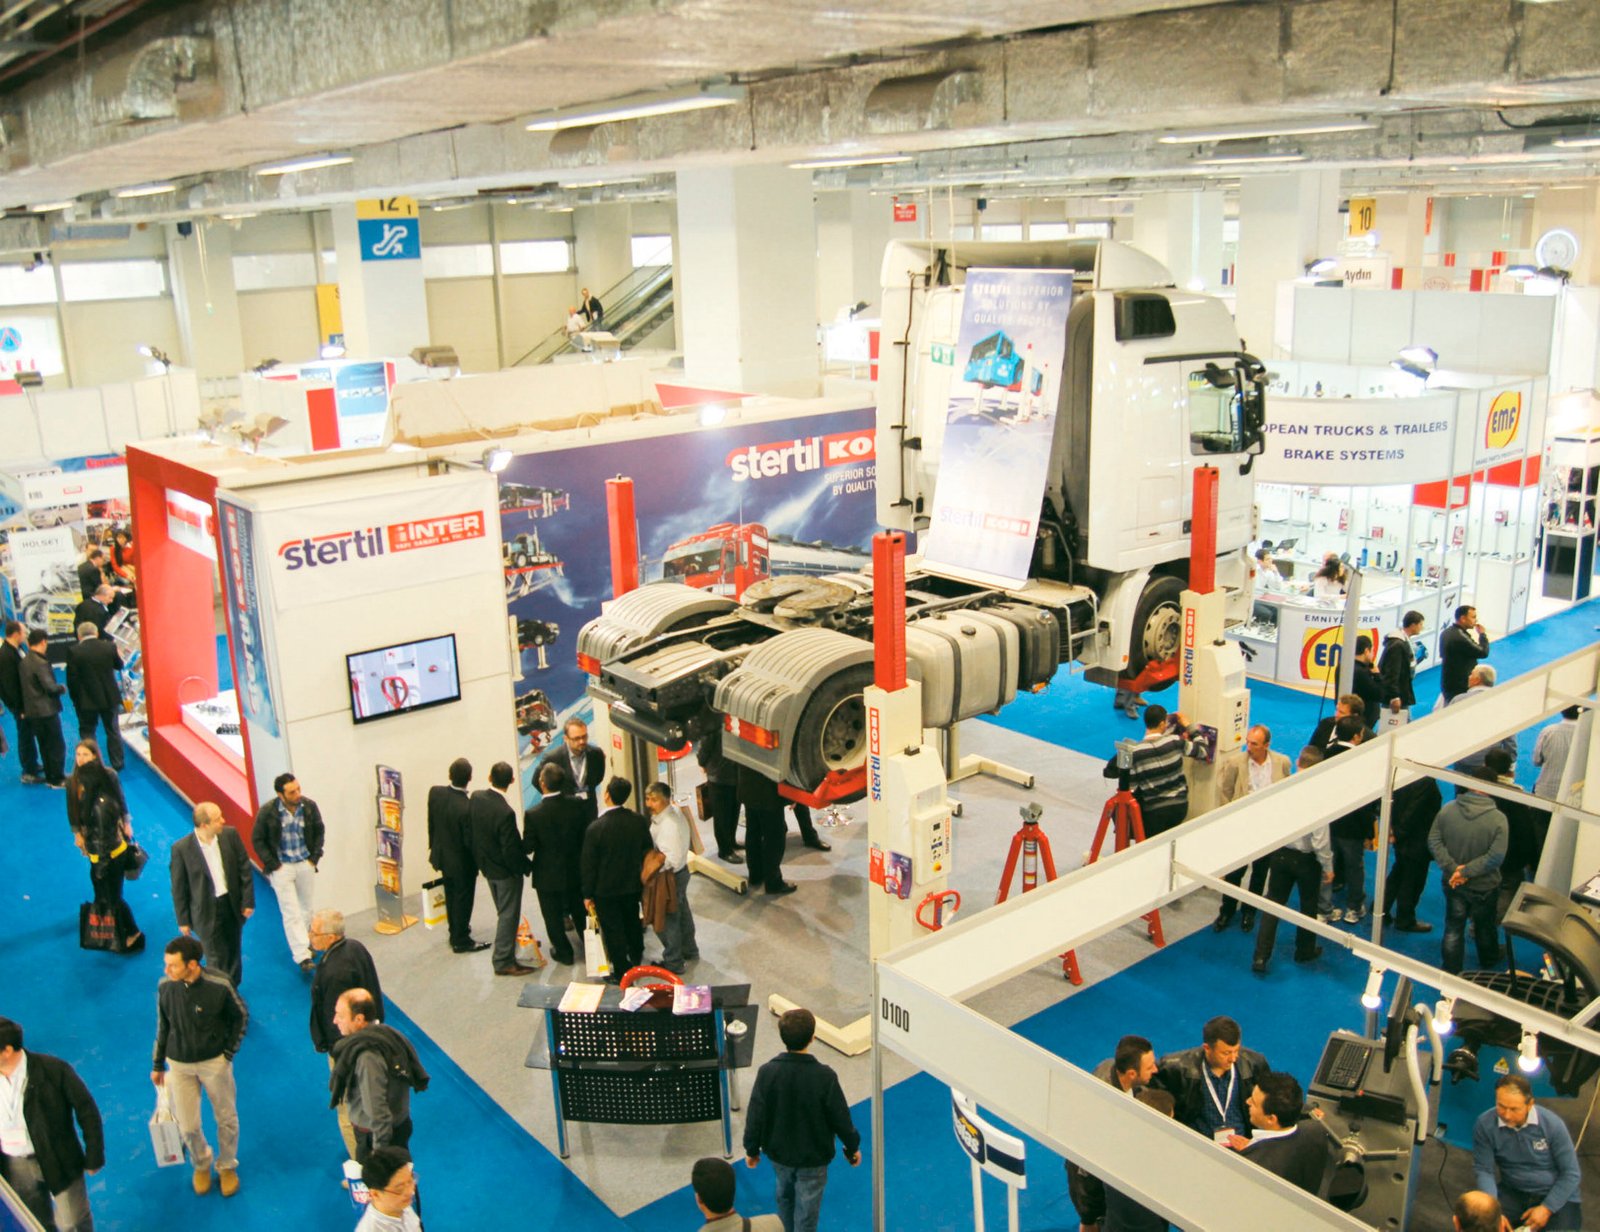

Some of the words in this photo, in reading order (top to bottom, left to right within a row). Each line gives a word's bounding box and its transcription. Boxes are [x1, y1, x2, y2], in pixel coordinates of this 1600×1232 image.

[1359, 206, 1372, 231] 10
[1261, 423, 1308, 435] OPEAN
[1314, 425, 1375, 436] TRUCKS
[1379, 425, 1389, 435] &
[1394, 421, 1448, 435] TRAILERS
[1491, 406, 1517, 433] EMF
[729, 436, 821, 482] stertil
[828, 434, 877, 460] KO
[1284, 449, 1335, 460] BRAKE
[1340, 449, 1405, 461] SYSTEMS
[824, 468, 864, 483] SUPERIOR
[866, 466, 877, 477] SO
[833, 485, 843, 496] BY
[281, 527, 385, 570] stertil
[1185, 608, 1195, 648] KONI
[1183, 648, 1194, 687] stertil
[870, 708, 880, 755] KONI
[870, 755, 881, 801] stertil
[881, 997, 910, 1033] D100
